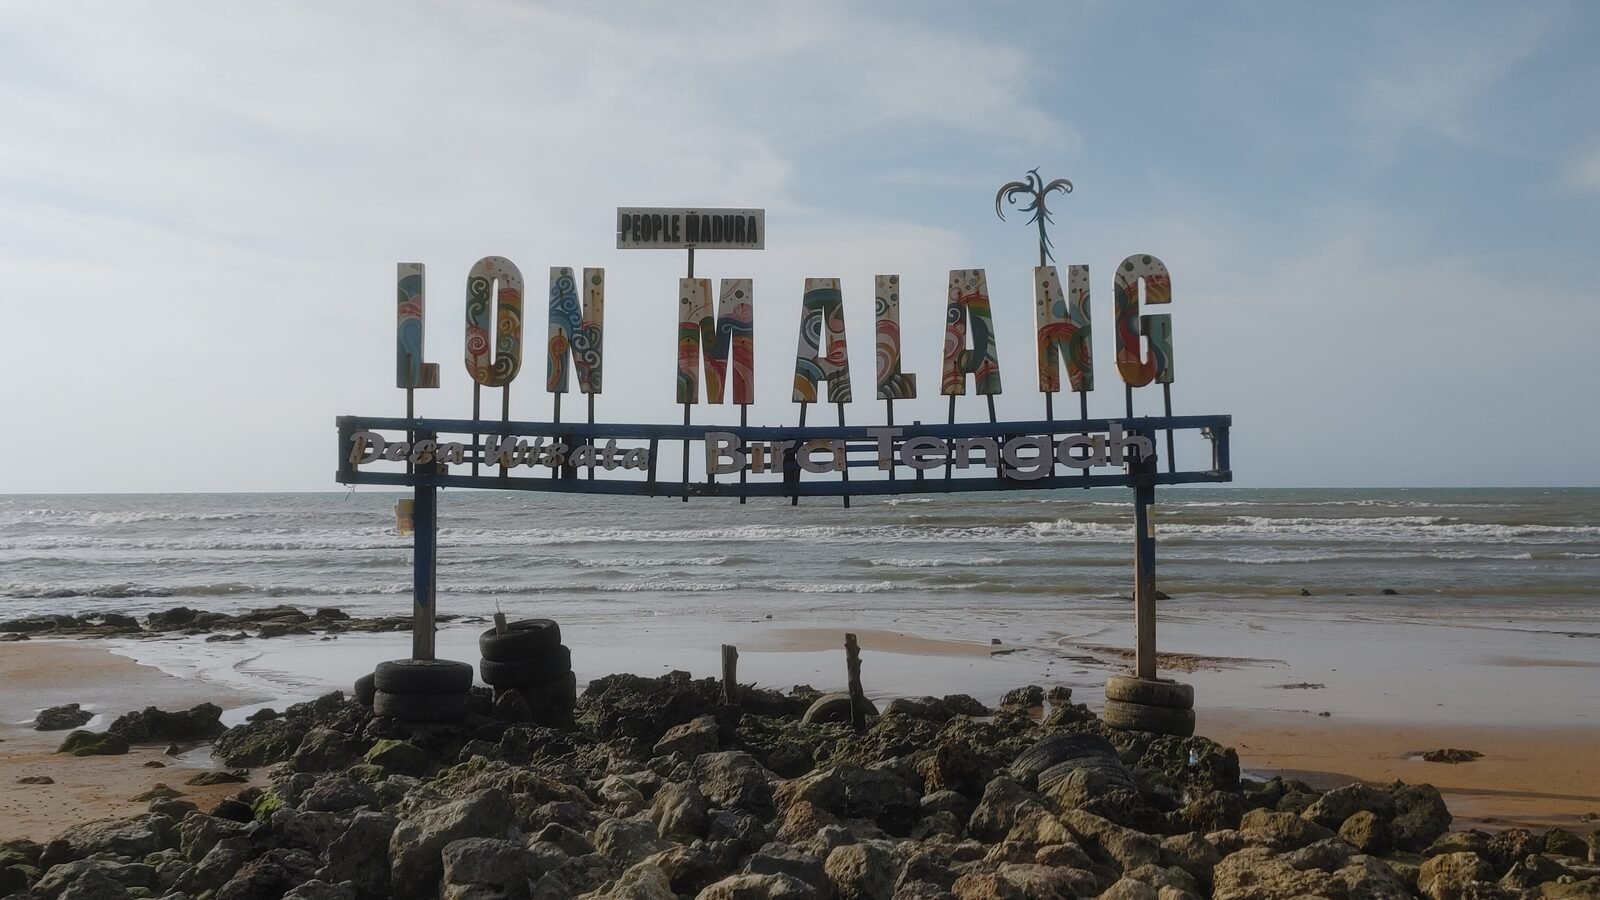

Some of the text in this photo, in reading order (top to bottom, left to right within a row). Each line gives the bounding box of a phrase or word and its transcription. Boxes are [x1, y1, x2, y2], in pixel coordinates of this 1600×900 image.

[621, 213, 758, 243] PEOPLE MADURA
[396, 253, 1174, 404] LON MALANG
[349, 422, 1154, 481] Desa Wisata Bira Tengah
